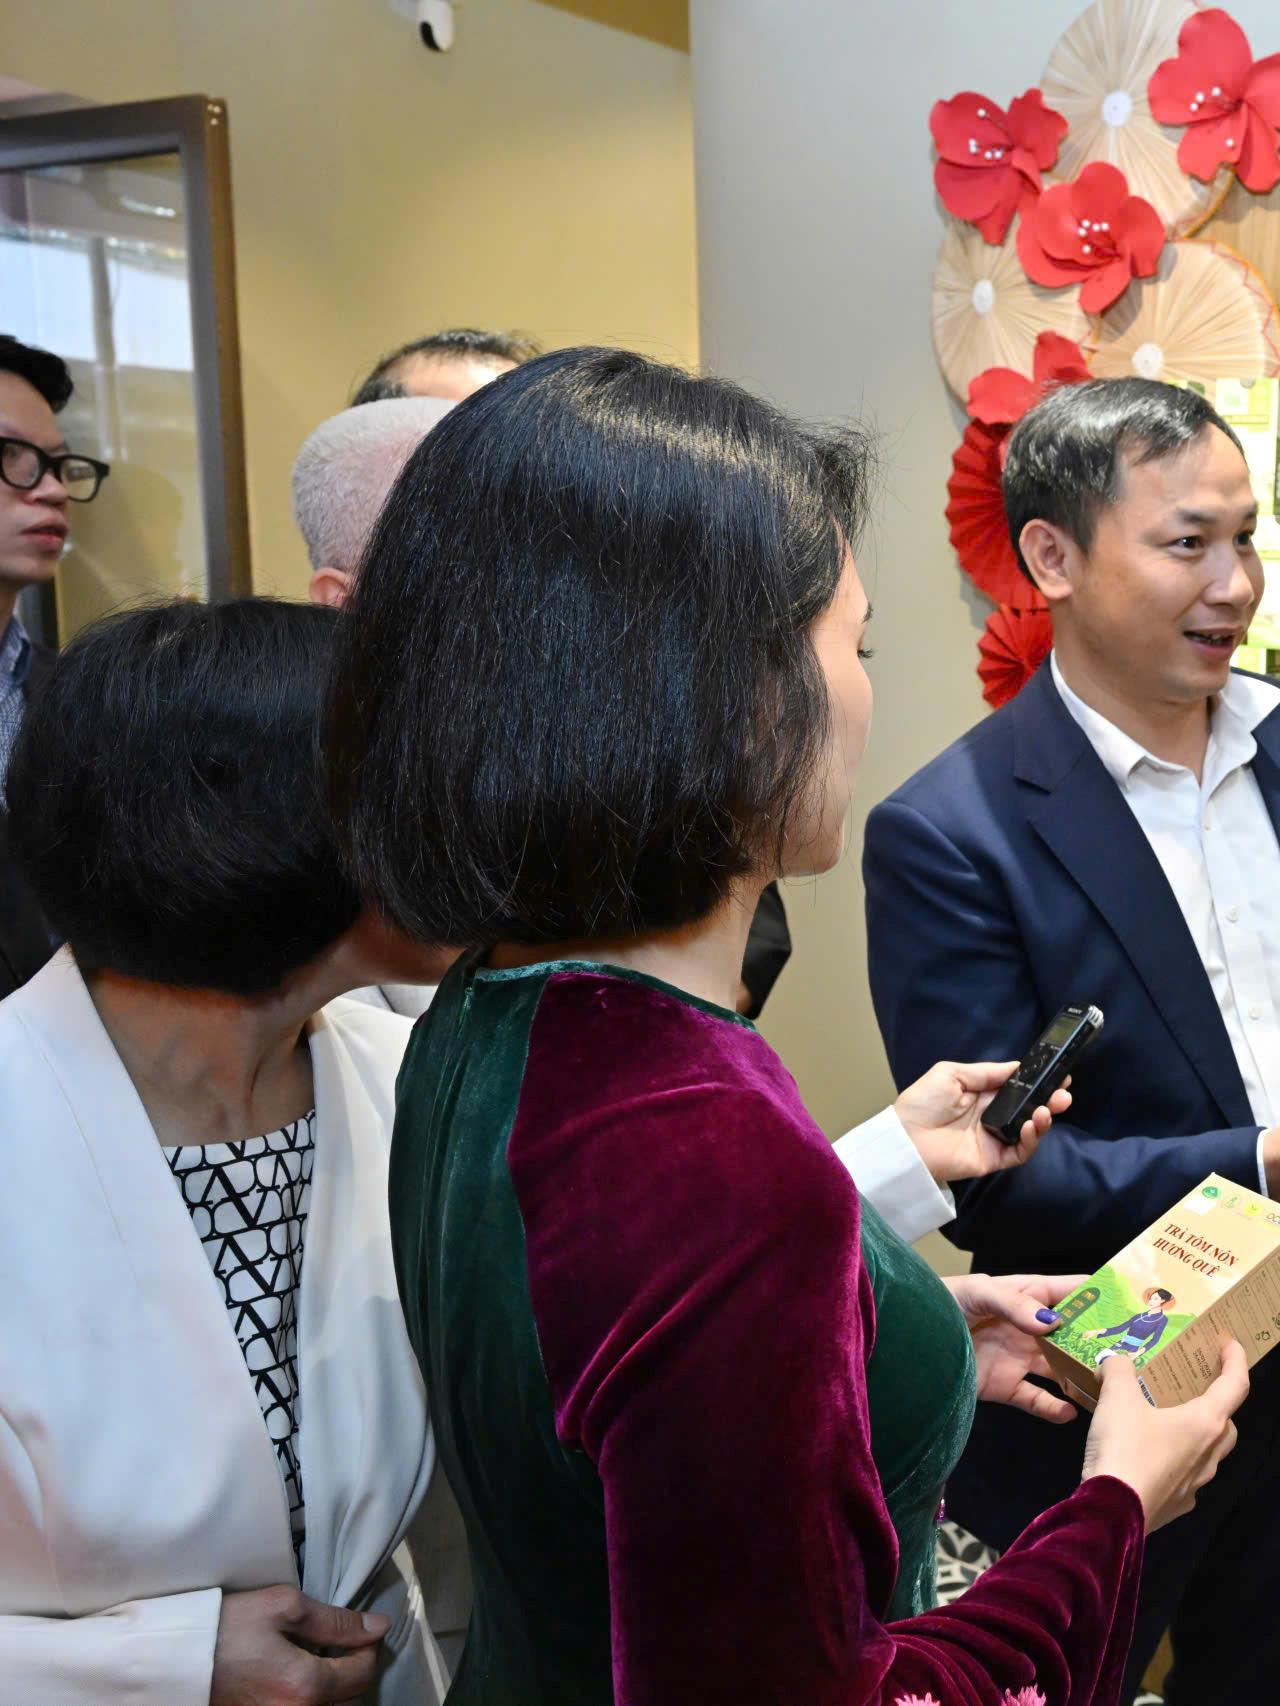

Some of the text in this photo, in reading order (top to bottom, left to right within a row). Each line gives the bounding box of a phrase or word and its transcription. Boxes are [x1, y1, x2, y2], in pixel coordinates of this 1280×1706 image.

[1164, 1223, 1188, 1240] TRÀ
[1185, 1233, 1213, 1253] TÔM
[1152, 1237, 1221, 1277] HƯƠNG QUÊ
